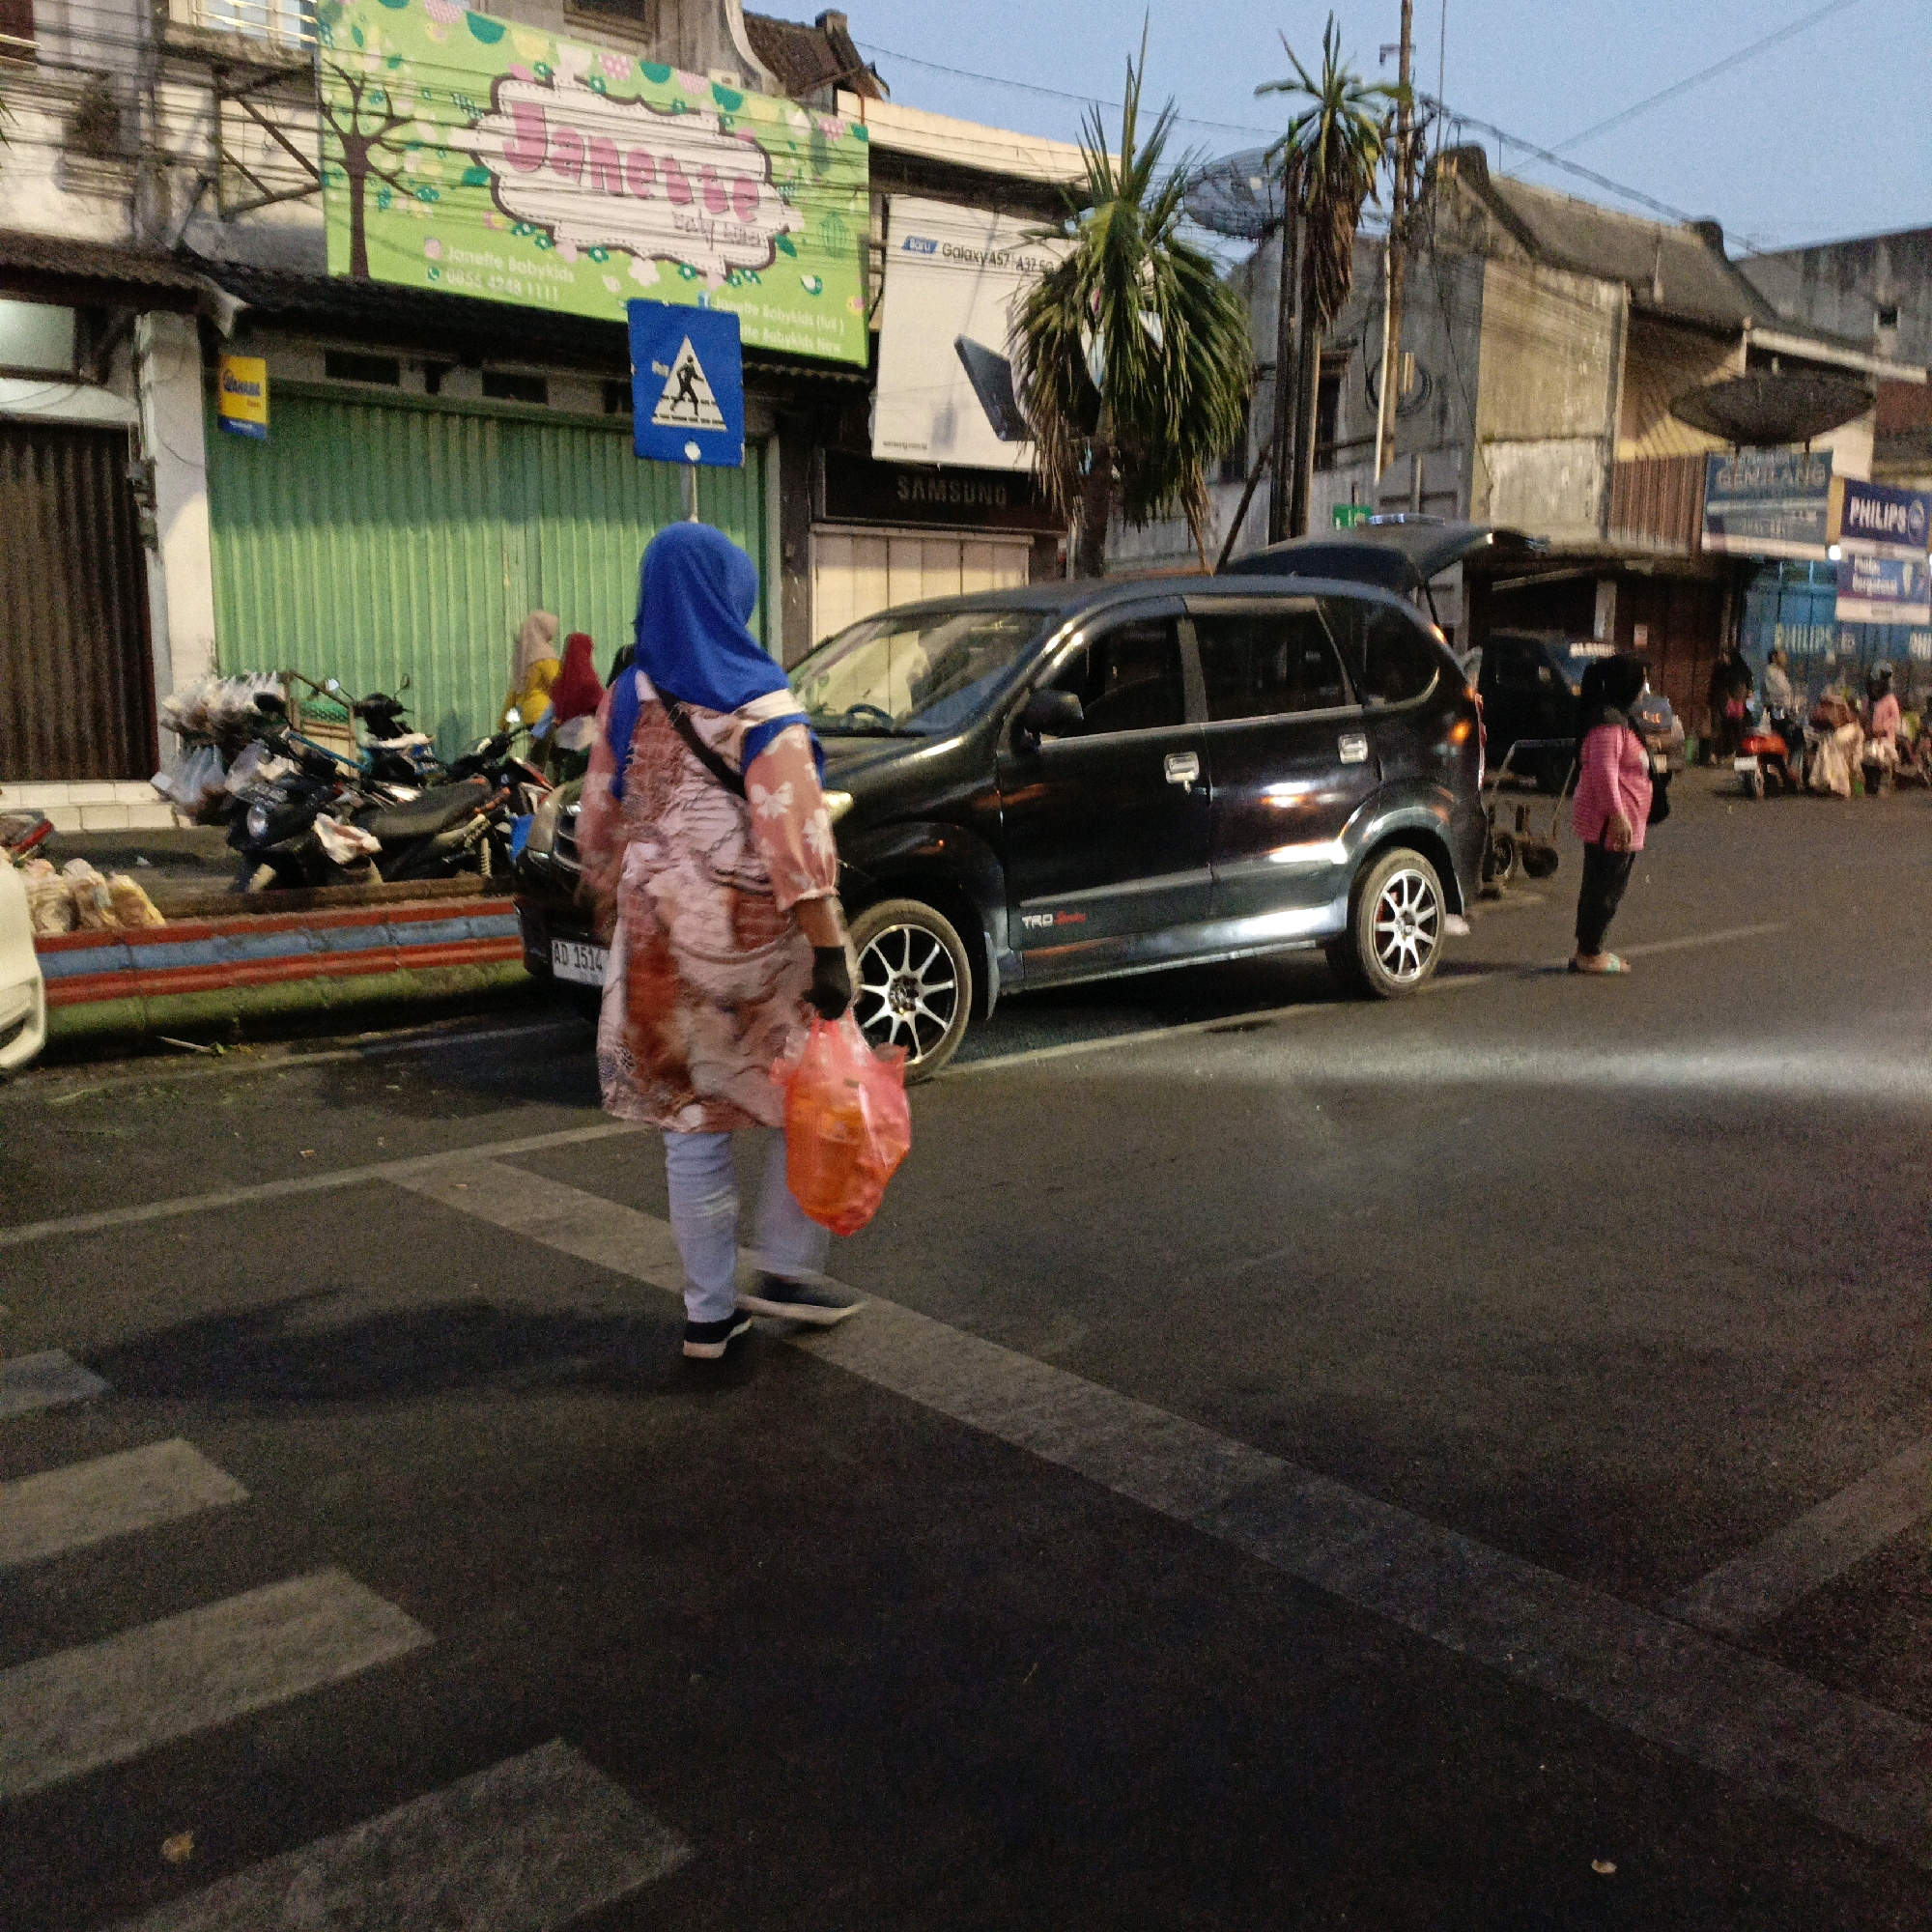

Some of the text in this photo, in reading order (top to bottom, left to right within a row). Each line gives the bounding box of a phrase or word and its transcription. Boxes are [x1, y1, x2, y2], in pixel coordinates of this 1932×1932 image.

[501, 100, 760, 223] Janette
[447, 245, 504, 271] Janette
[942, 242, 986, 265] Galaxy
[897, 474, 1008, 508] SAMSUNG
[1849, 496, 1907, 535] PHILIPS
[1022, 913, 1054, 929] TRD
[554, 941, 569, 965] AD
